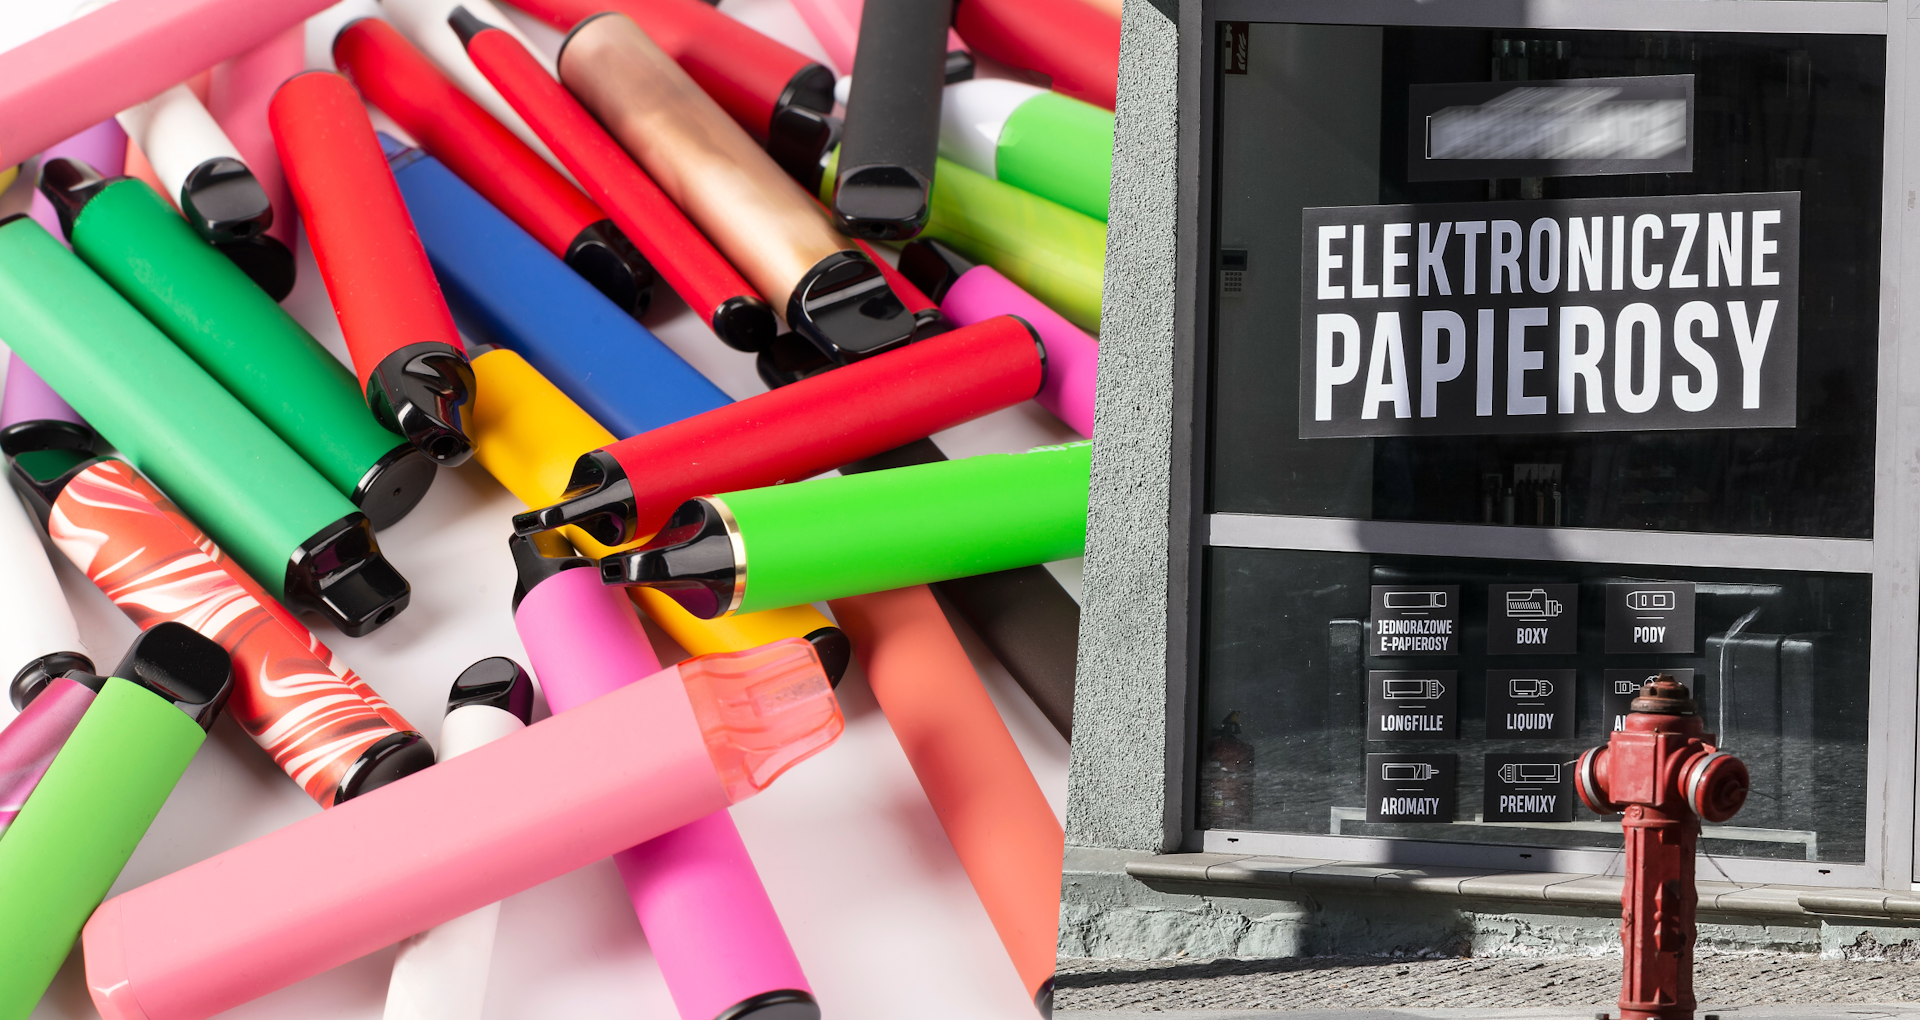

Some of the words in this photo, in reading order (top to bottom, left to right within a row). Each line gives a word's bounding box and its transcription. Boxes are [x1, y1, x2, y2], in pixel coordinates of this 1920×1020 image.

[1317, 210, 1781, 300] ELEKTRONICZNE
[1315, 300, 1779, 421] PAPIEROSY
[1377, 619, 1452, 635] JEDNORAZOWE
[1516, 627, 1549, 644] BOXY
[1633, 626, 1666, 643] PODY
[1381, 636, 1448, 651] E-PAPIEROSY
[1381, 715, 1443, 731] LONGFILLE
[1506, 713, 1554, 731] LIQUIDY
[1381, 797, 1439, 815] AROMATY
[1500, 795, 1556, 813] PREMIXY
